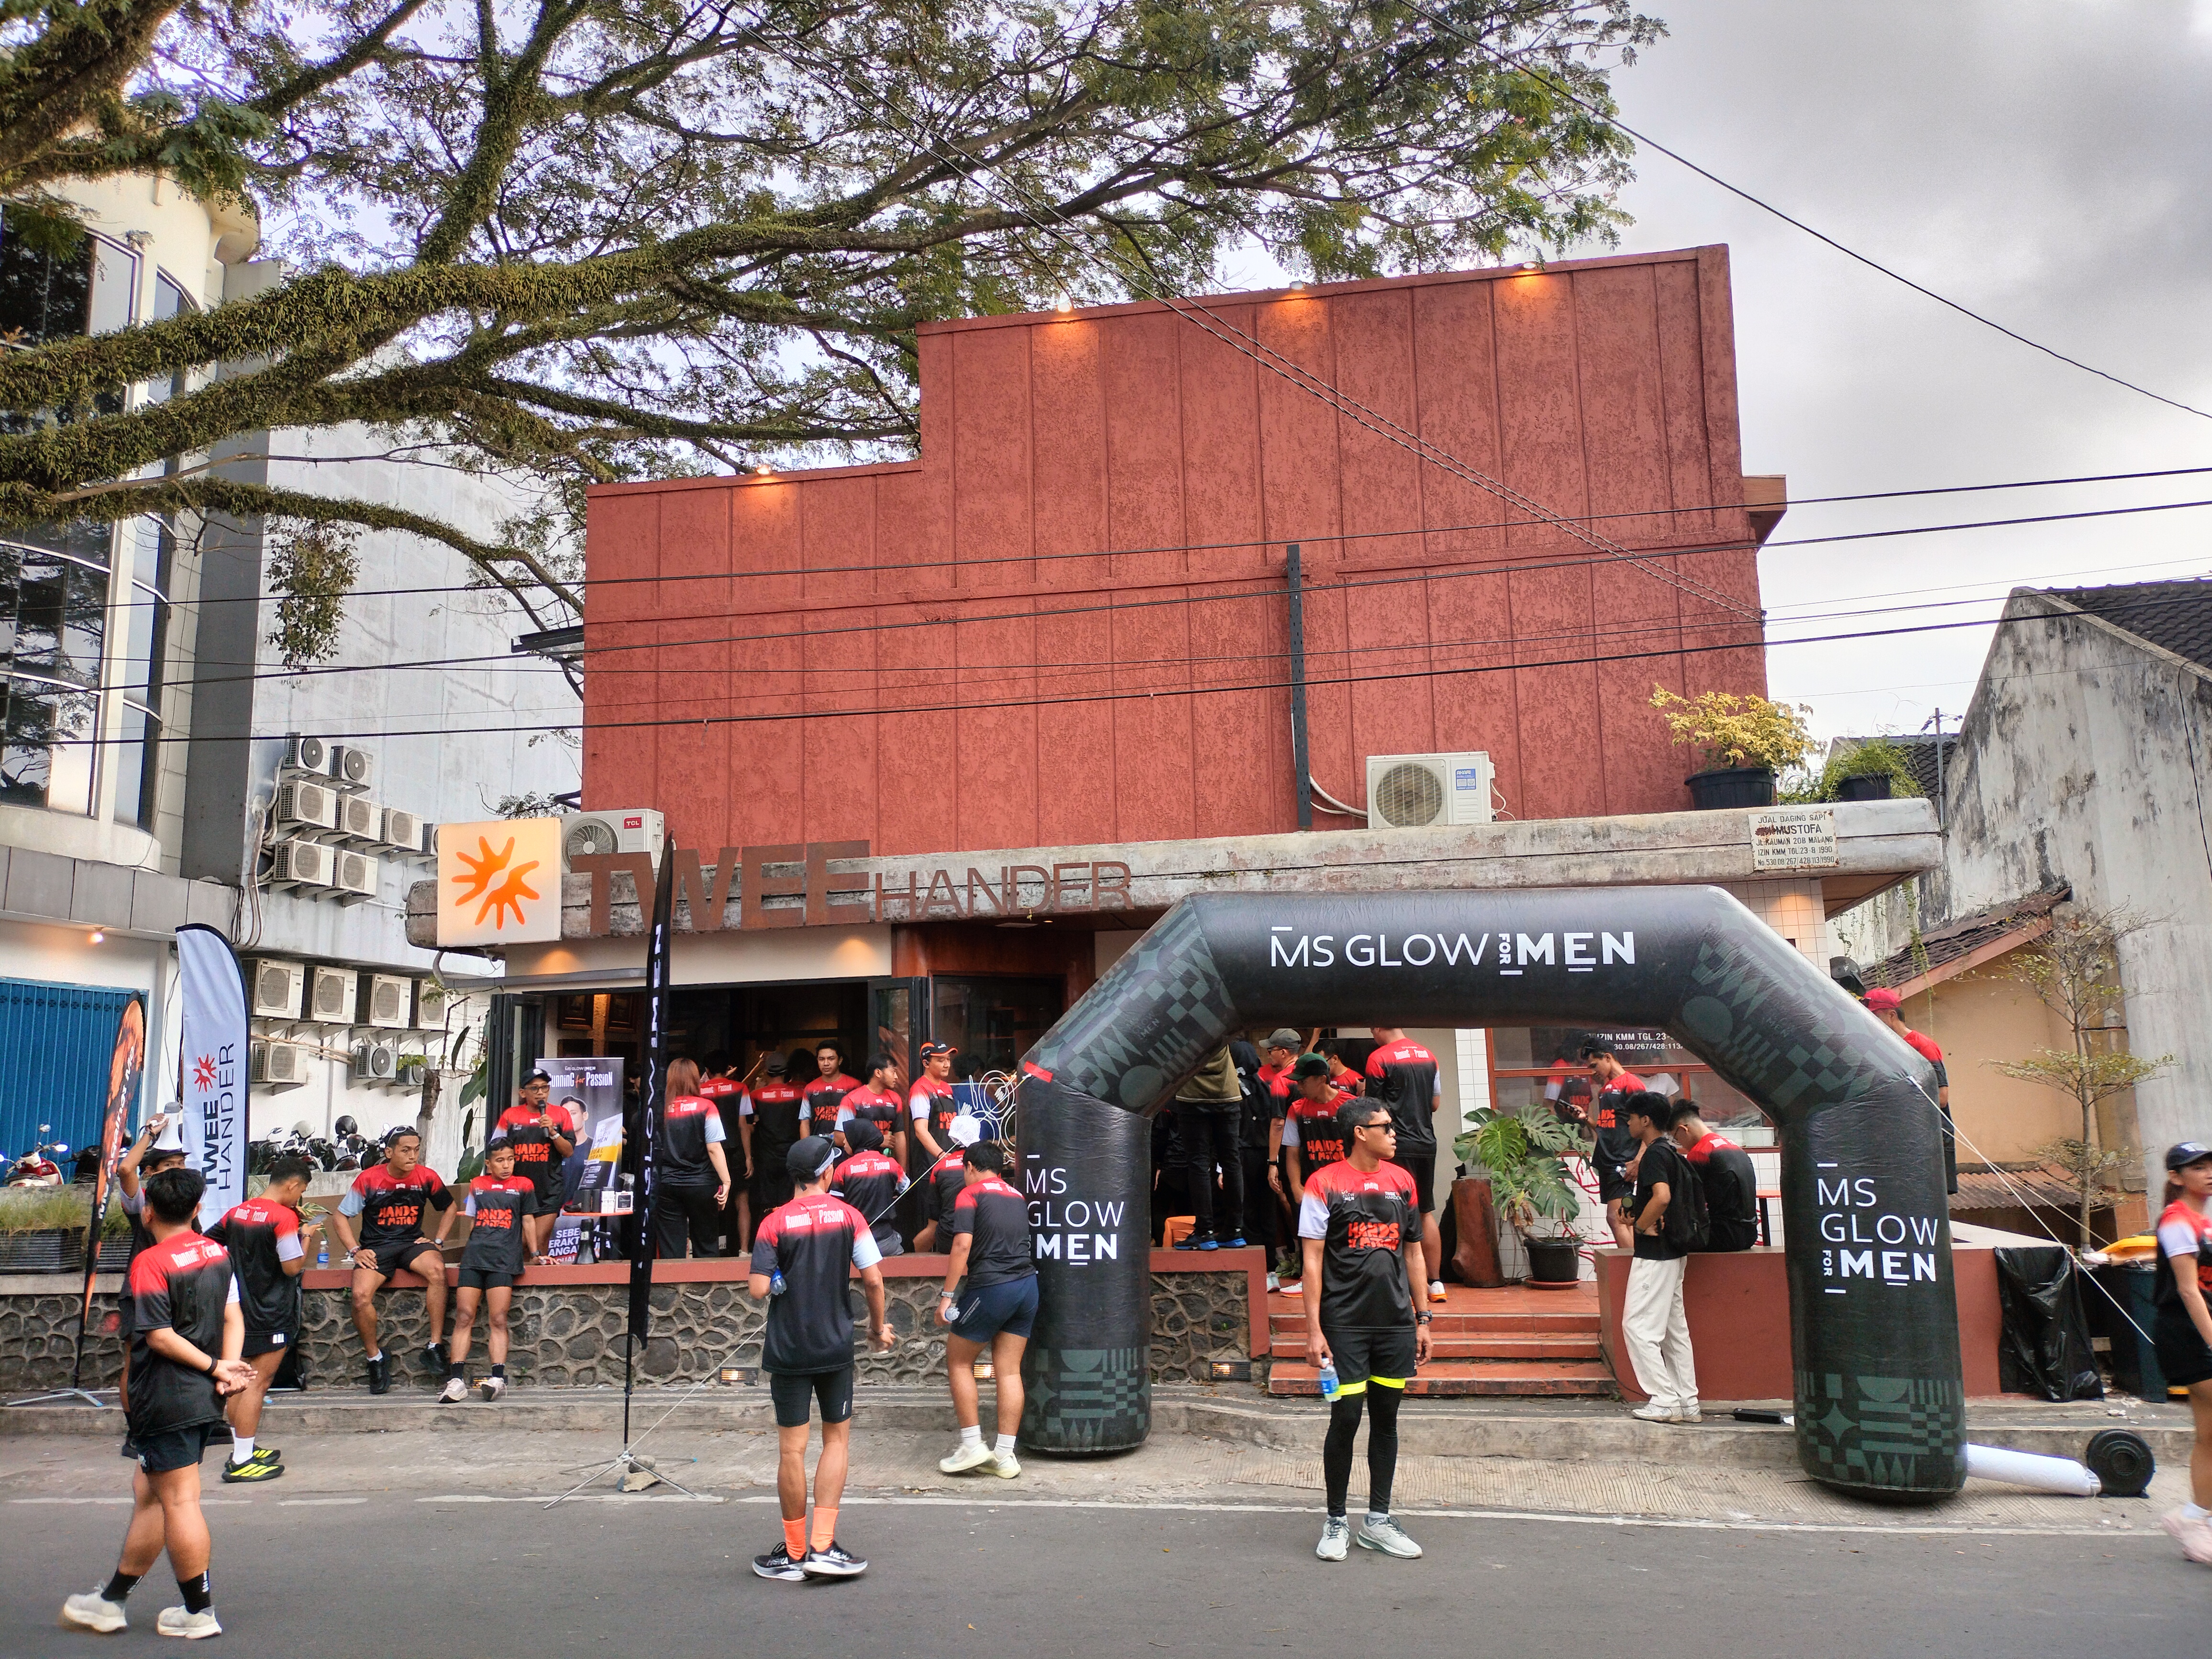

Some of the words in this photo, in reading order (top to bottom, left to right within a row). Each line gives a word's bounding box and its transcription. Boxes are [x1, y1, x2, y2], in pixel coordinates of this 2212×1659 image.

[1775, 824, 1822, 835] MUSTOFA
[1772, 847, 1786, 855] KMM
[571, 840, 870, 935] TWEE
[875, 861, 1135, 922] HANDER
[1271, 935, 1334, 967] MS
[1345, 933, 1489, 967] GLOW
[1498, 933, 1511, 965] FOR
[1517, 931, 1635, 965] MEN
[1615, 1033, 1635, 1041] KMM
[575, 1074, 586, 1088] for
[218, 1042, 234, 1190] HANDER
[201, 1099, 219, 1185] TWEE
[514, 1143, 551, 1155] HANDS
[1306, 1139, 1344, 1153] HANDS
[1026, 1168, 1067, 1194] MS
[1818, 1178, 1877, 1207] MS
[378, 1206, 419, 1218] HANDS
[476, 1208, 512, 1220] HANDS
[1027, 1201, 1124, 1228] GLOW
[1348, 1222, 1400, 1239] HANDS
[1821, 1213, 1938, 1246] GLOW
[1036, 1234, 1117, 1260] MEN
[1822, 1250, 1833, 1276] FOR
[1840, 1249, 1936, 1282] MEN
[766, 1556, 789, 1566] HOKA
